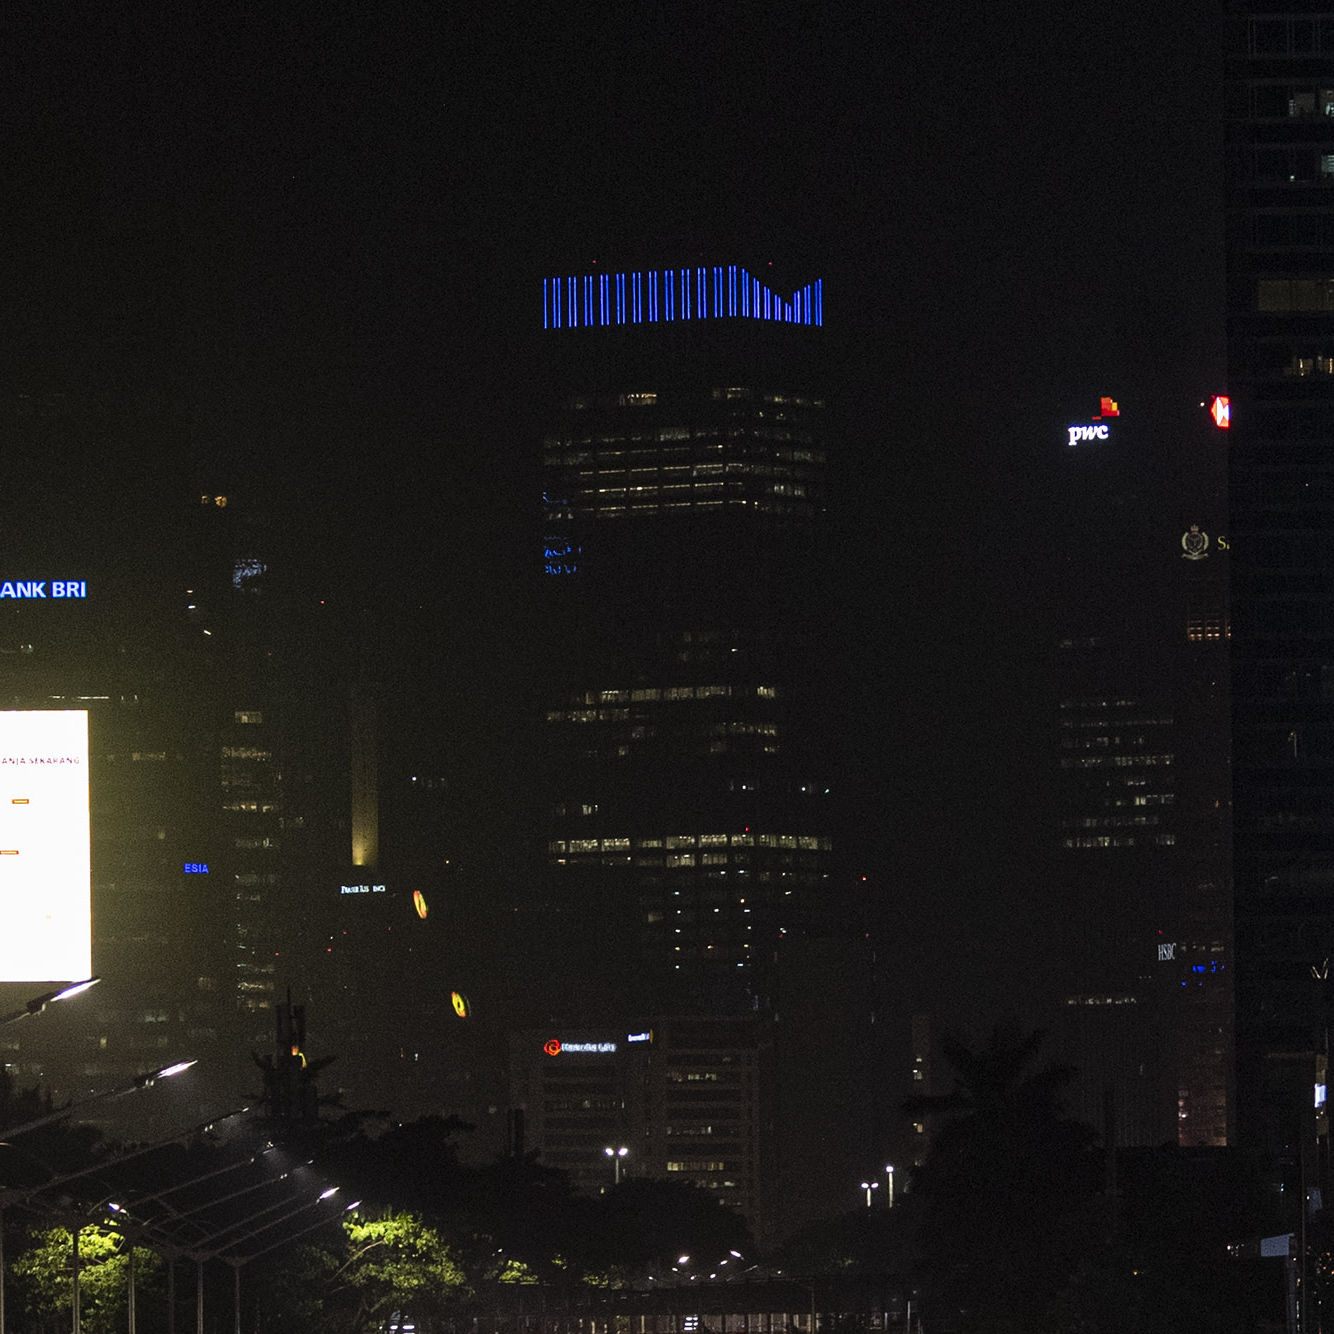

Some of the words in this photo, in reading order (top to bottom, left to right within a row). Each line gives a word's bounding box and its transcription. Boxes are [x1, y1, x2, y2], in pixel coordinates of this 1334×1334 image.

[1068, 424, 1109, 446] pwc
[51, 580, 87, 598] BRI
[1157, 942, 1177, 961] HSBC
